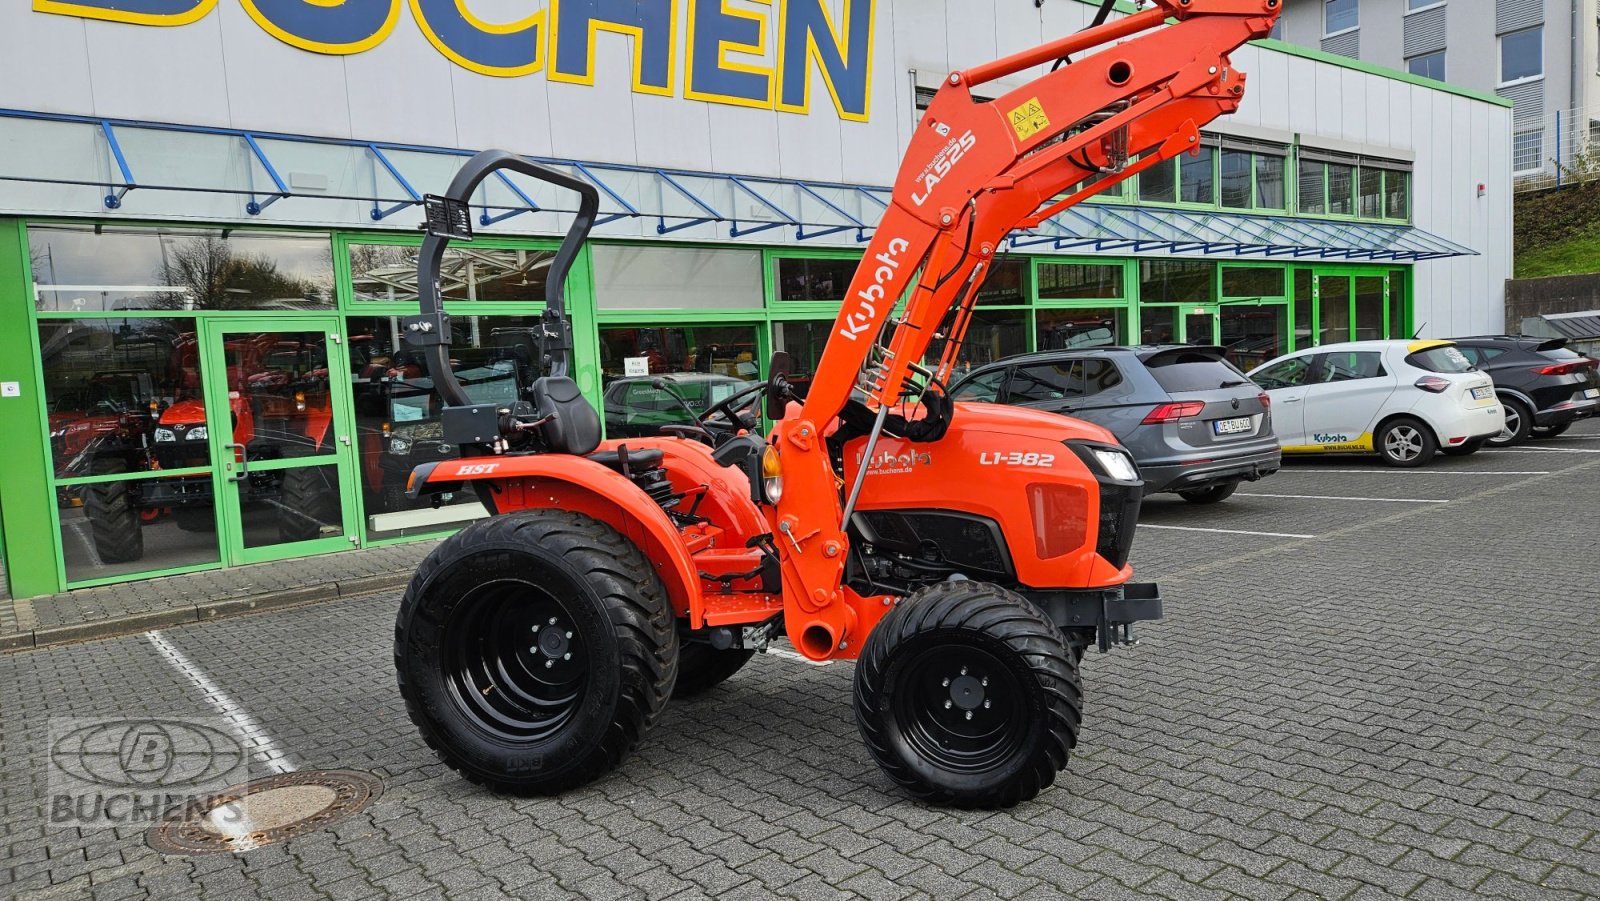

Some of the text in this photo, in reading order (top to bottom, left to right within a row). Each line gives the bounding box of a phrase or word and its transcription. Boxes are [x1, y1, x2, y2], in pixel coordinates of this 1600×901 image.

[33, 0, 876, 122] CHEN
[911, 129, 976, 206] LA525
[914, 136, 957, 183] www.buchens.de
[840, 237, 909, 341] Kubota
[979, 451, 1055, 467] L1-382
[1313, 433, 1348, 443] Kubota
[455, 463, 500, 476] HST
